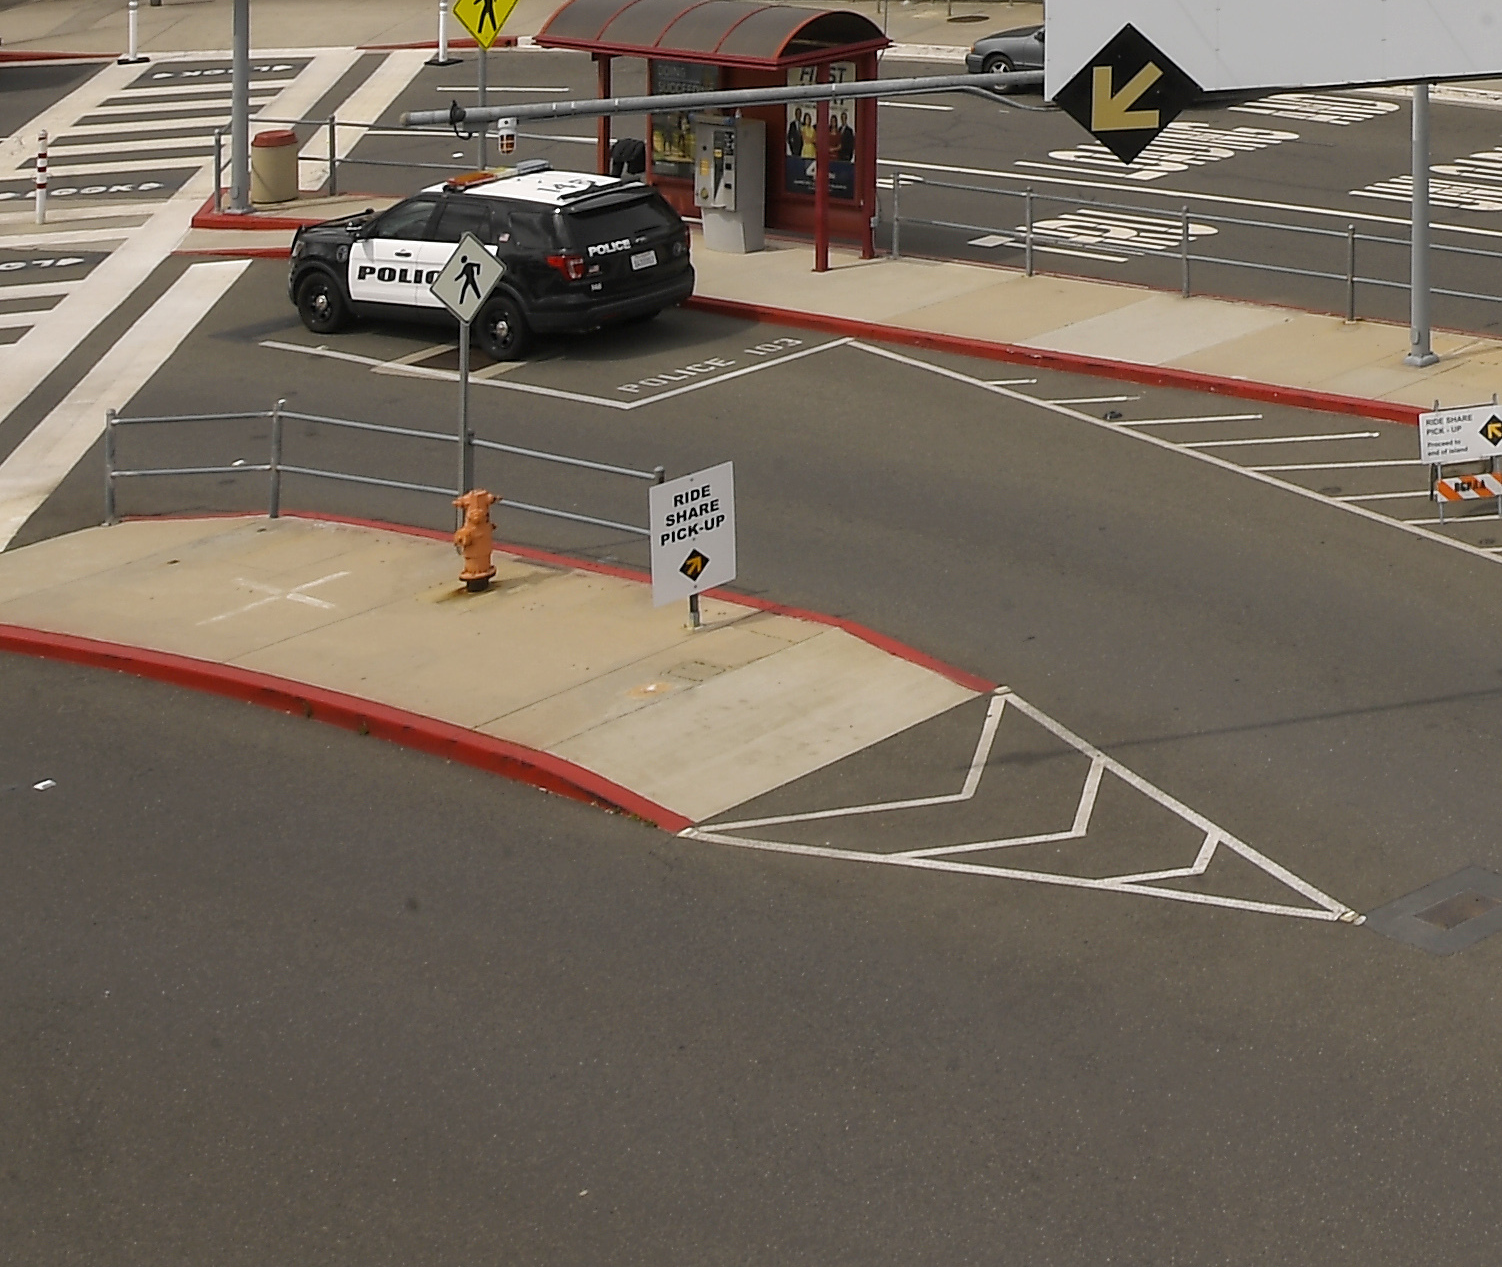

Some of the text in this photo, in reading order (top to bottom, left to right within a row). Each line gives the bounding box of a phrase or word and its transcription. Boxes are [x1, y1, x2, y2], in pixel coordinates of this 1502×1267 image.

[800, 67, 847, 83] FIST
[588, 238, 632, 258] POLICE
[357, 266, 441, 285] POLIC
[617, 357, 736, 393] POLICE
[1425, 414, 1473, 426] RIDE SHARE
[1426, 426, 1445, 436] PICK
[1451, 425, 1462, 433] UP
[673, 485, 711, 507] RIDE
[666, 499, 720, 527] SHARE
[661, 514, 725, 546] PICK-UP
